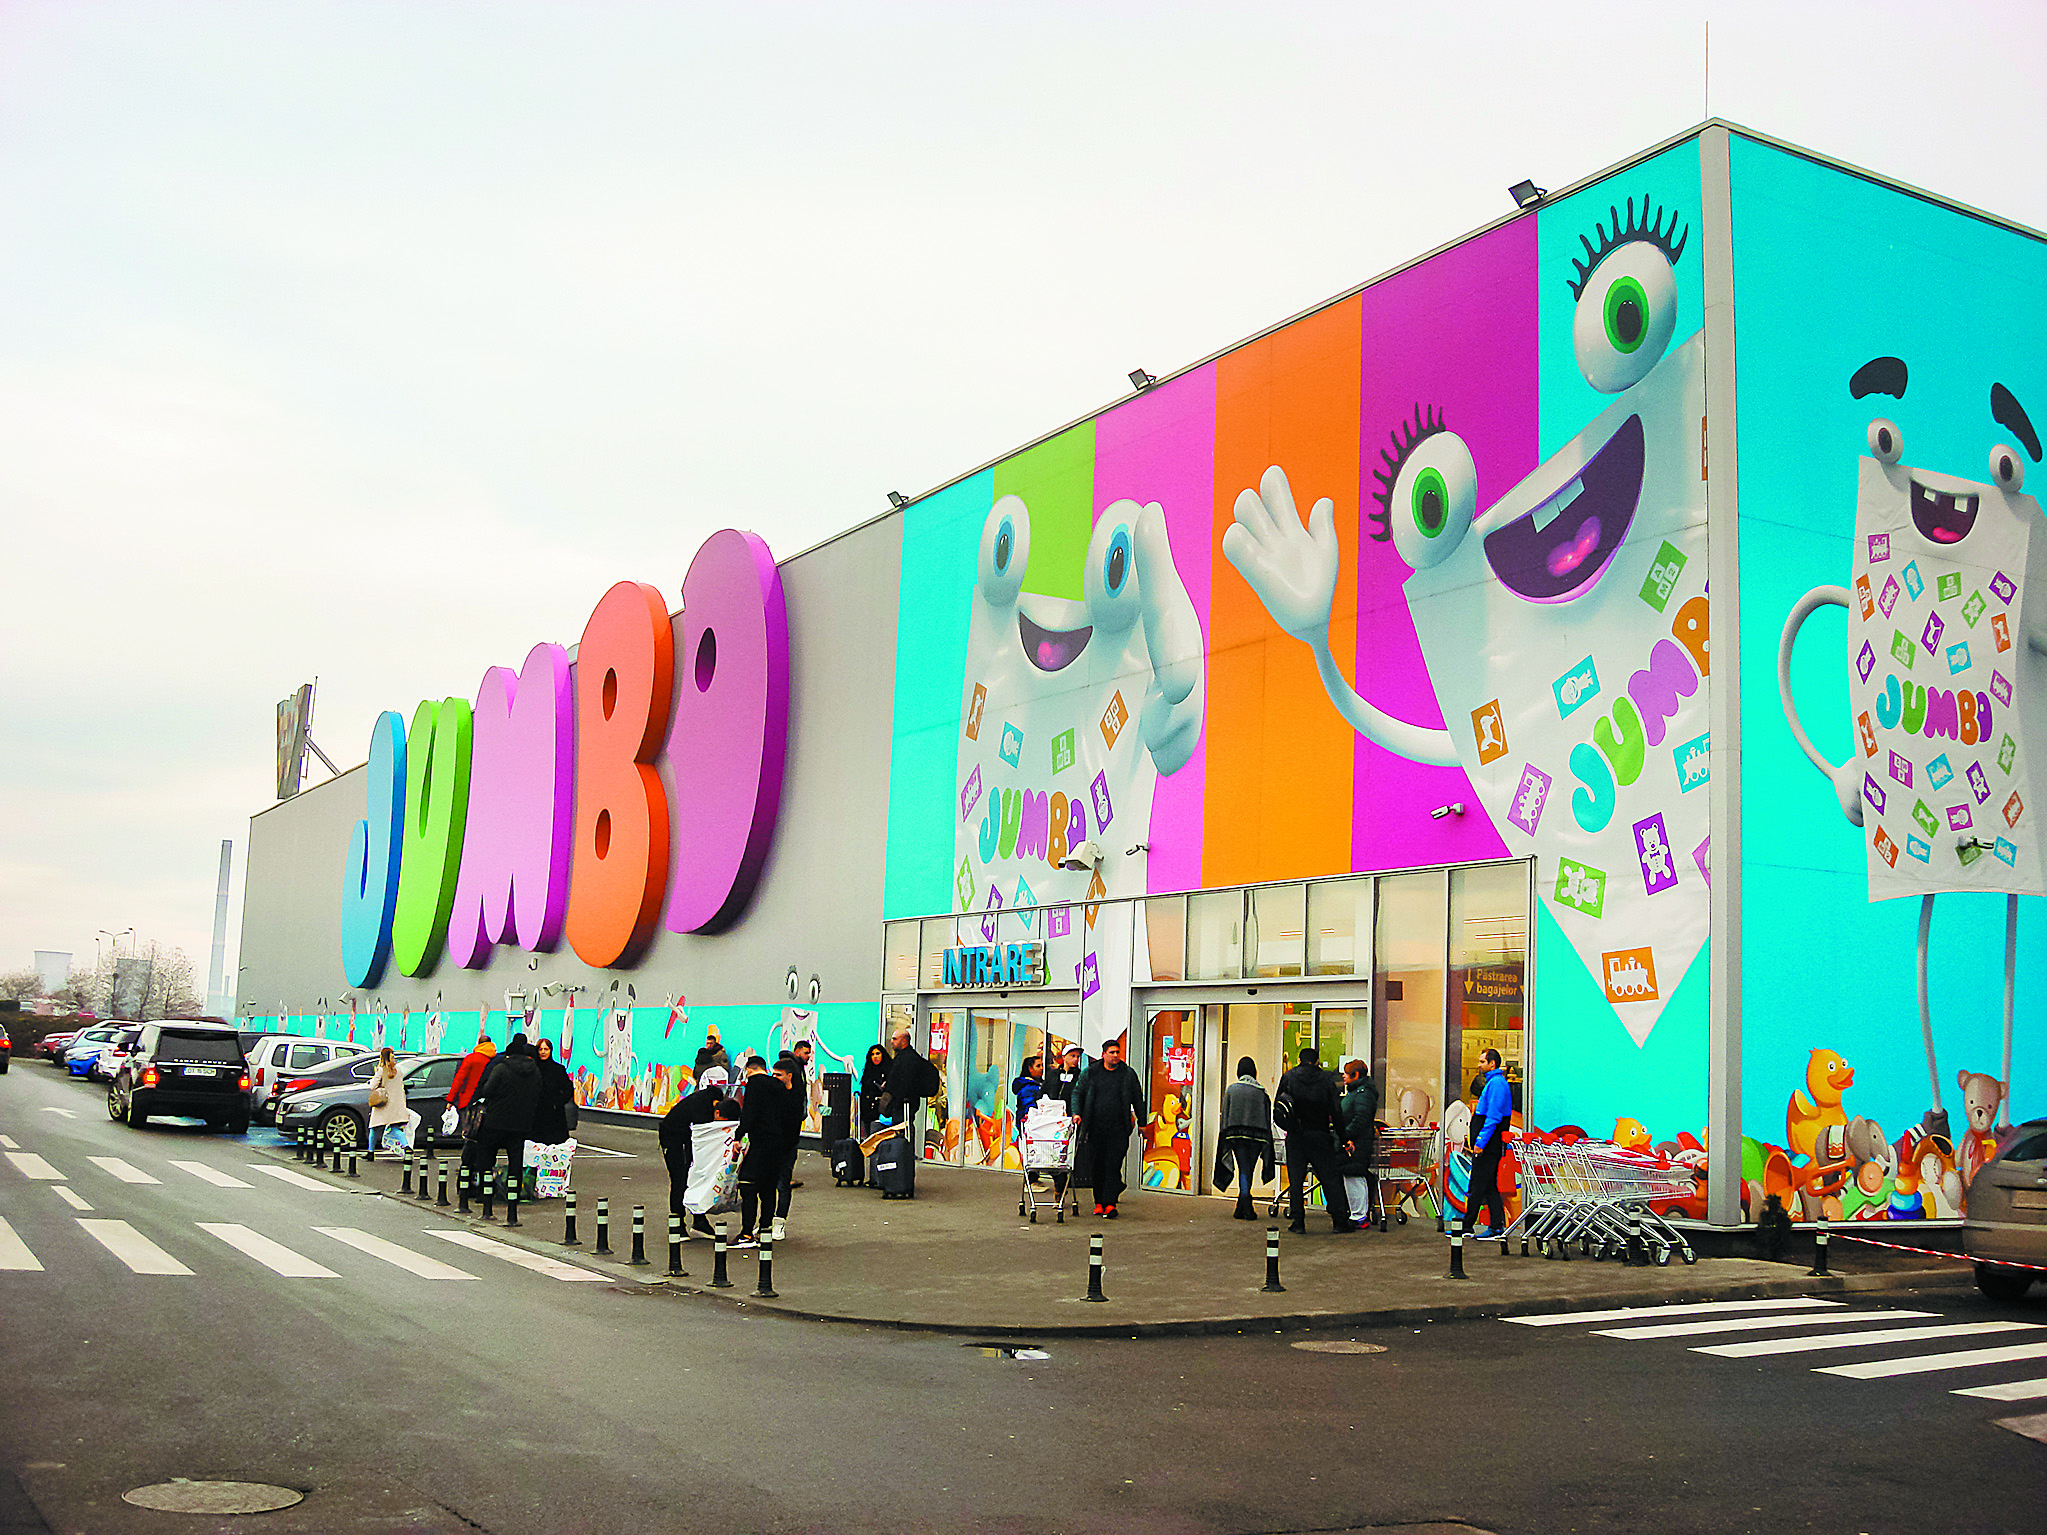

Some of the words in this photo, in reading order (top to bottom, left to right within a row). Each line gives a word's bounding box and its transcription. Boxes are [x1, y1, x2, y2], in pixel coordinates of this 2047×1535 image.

[1569, 580, 1709, 833] JUMB
[1875, 673, 1993, 746] JUMBO
[341, 529, 789, 988] JUMBO
[941, 943, 1034, 985] INTRARE
[1476, 982, 1517, 997] bagajelor
